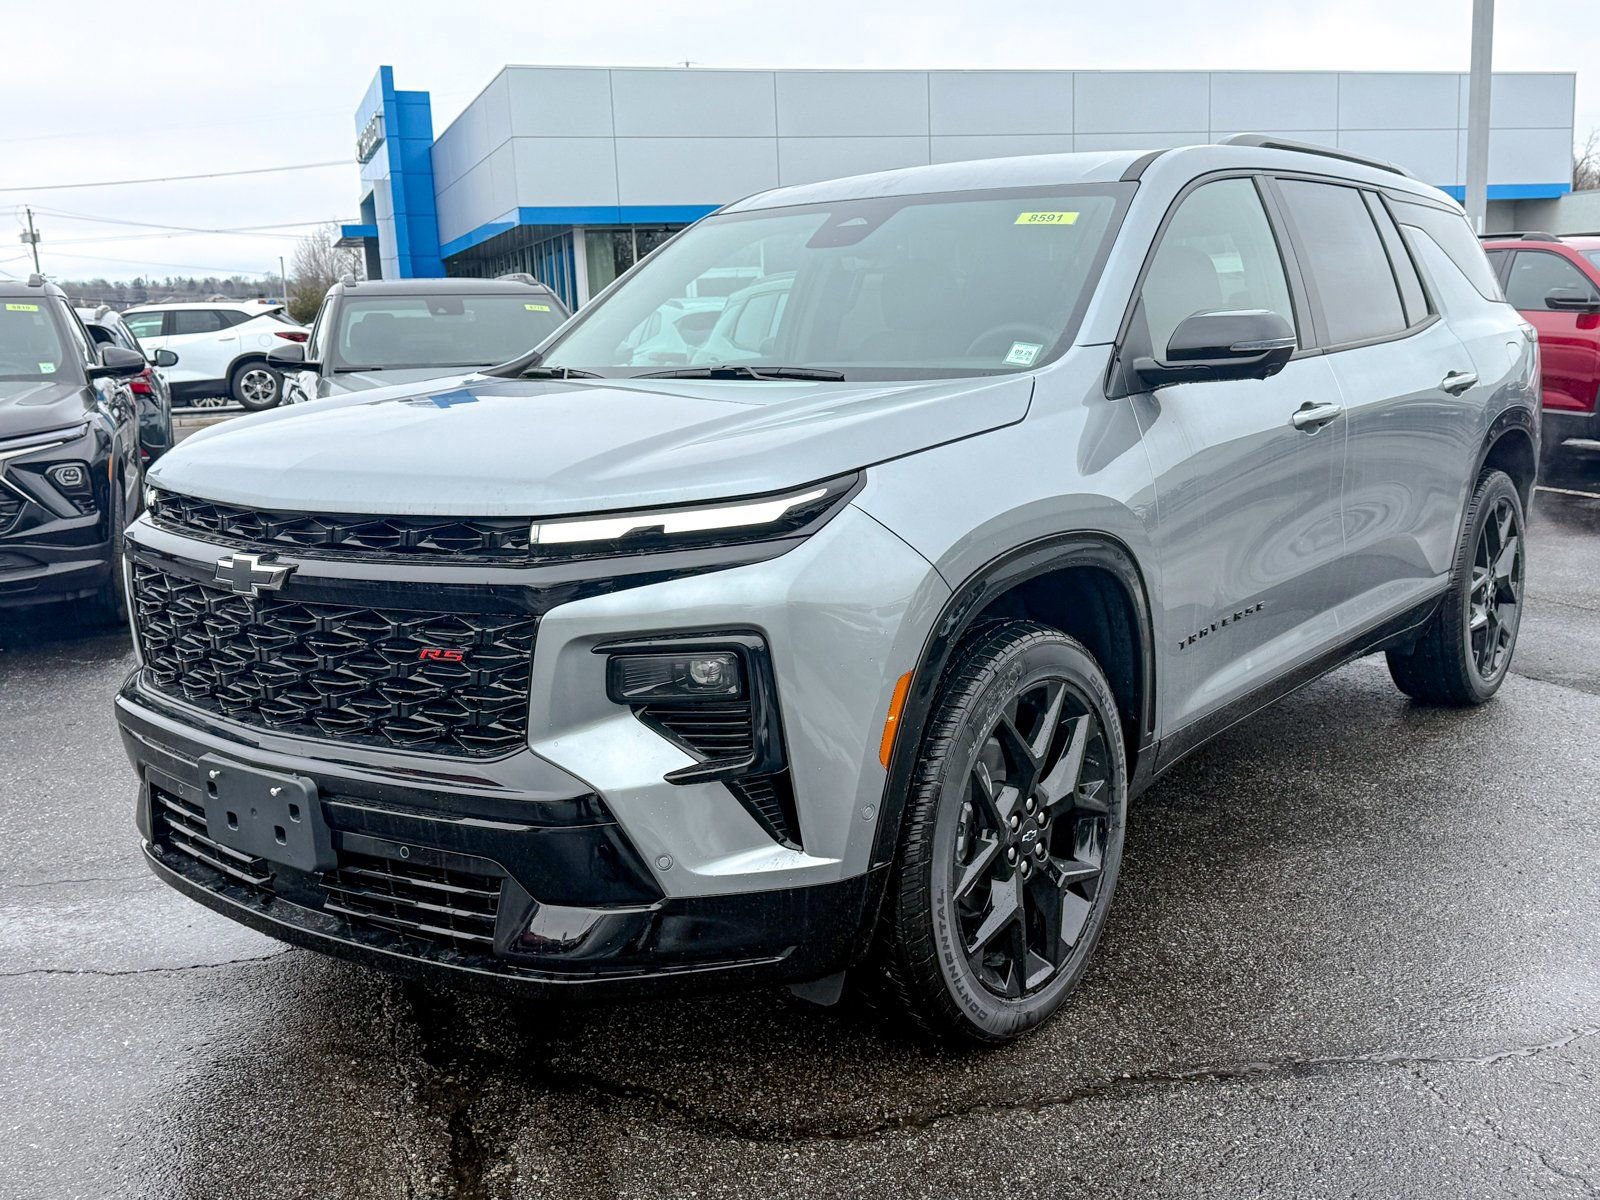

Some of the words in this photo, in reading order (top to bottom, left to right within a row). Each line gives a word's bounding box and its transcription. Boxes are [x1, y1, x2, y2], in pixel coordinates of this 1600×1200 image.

[1028, 213, 1064, 223] 8591
[1178, 601, 1265, 650] TRAVERSE
[419, 648, 463, 662] RS
[1088, 672, 1125, 791] CONTINENTAL
[937, 888, 988, 1021] CONTINENTAL
